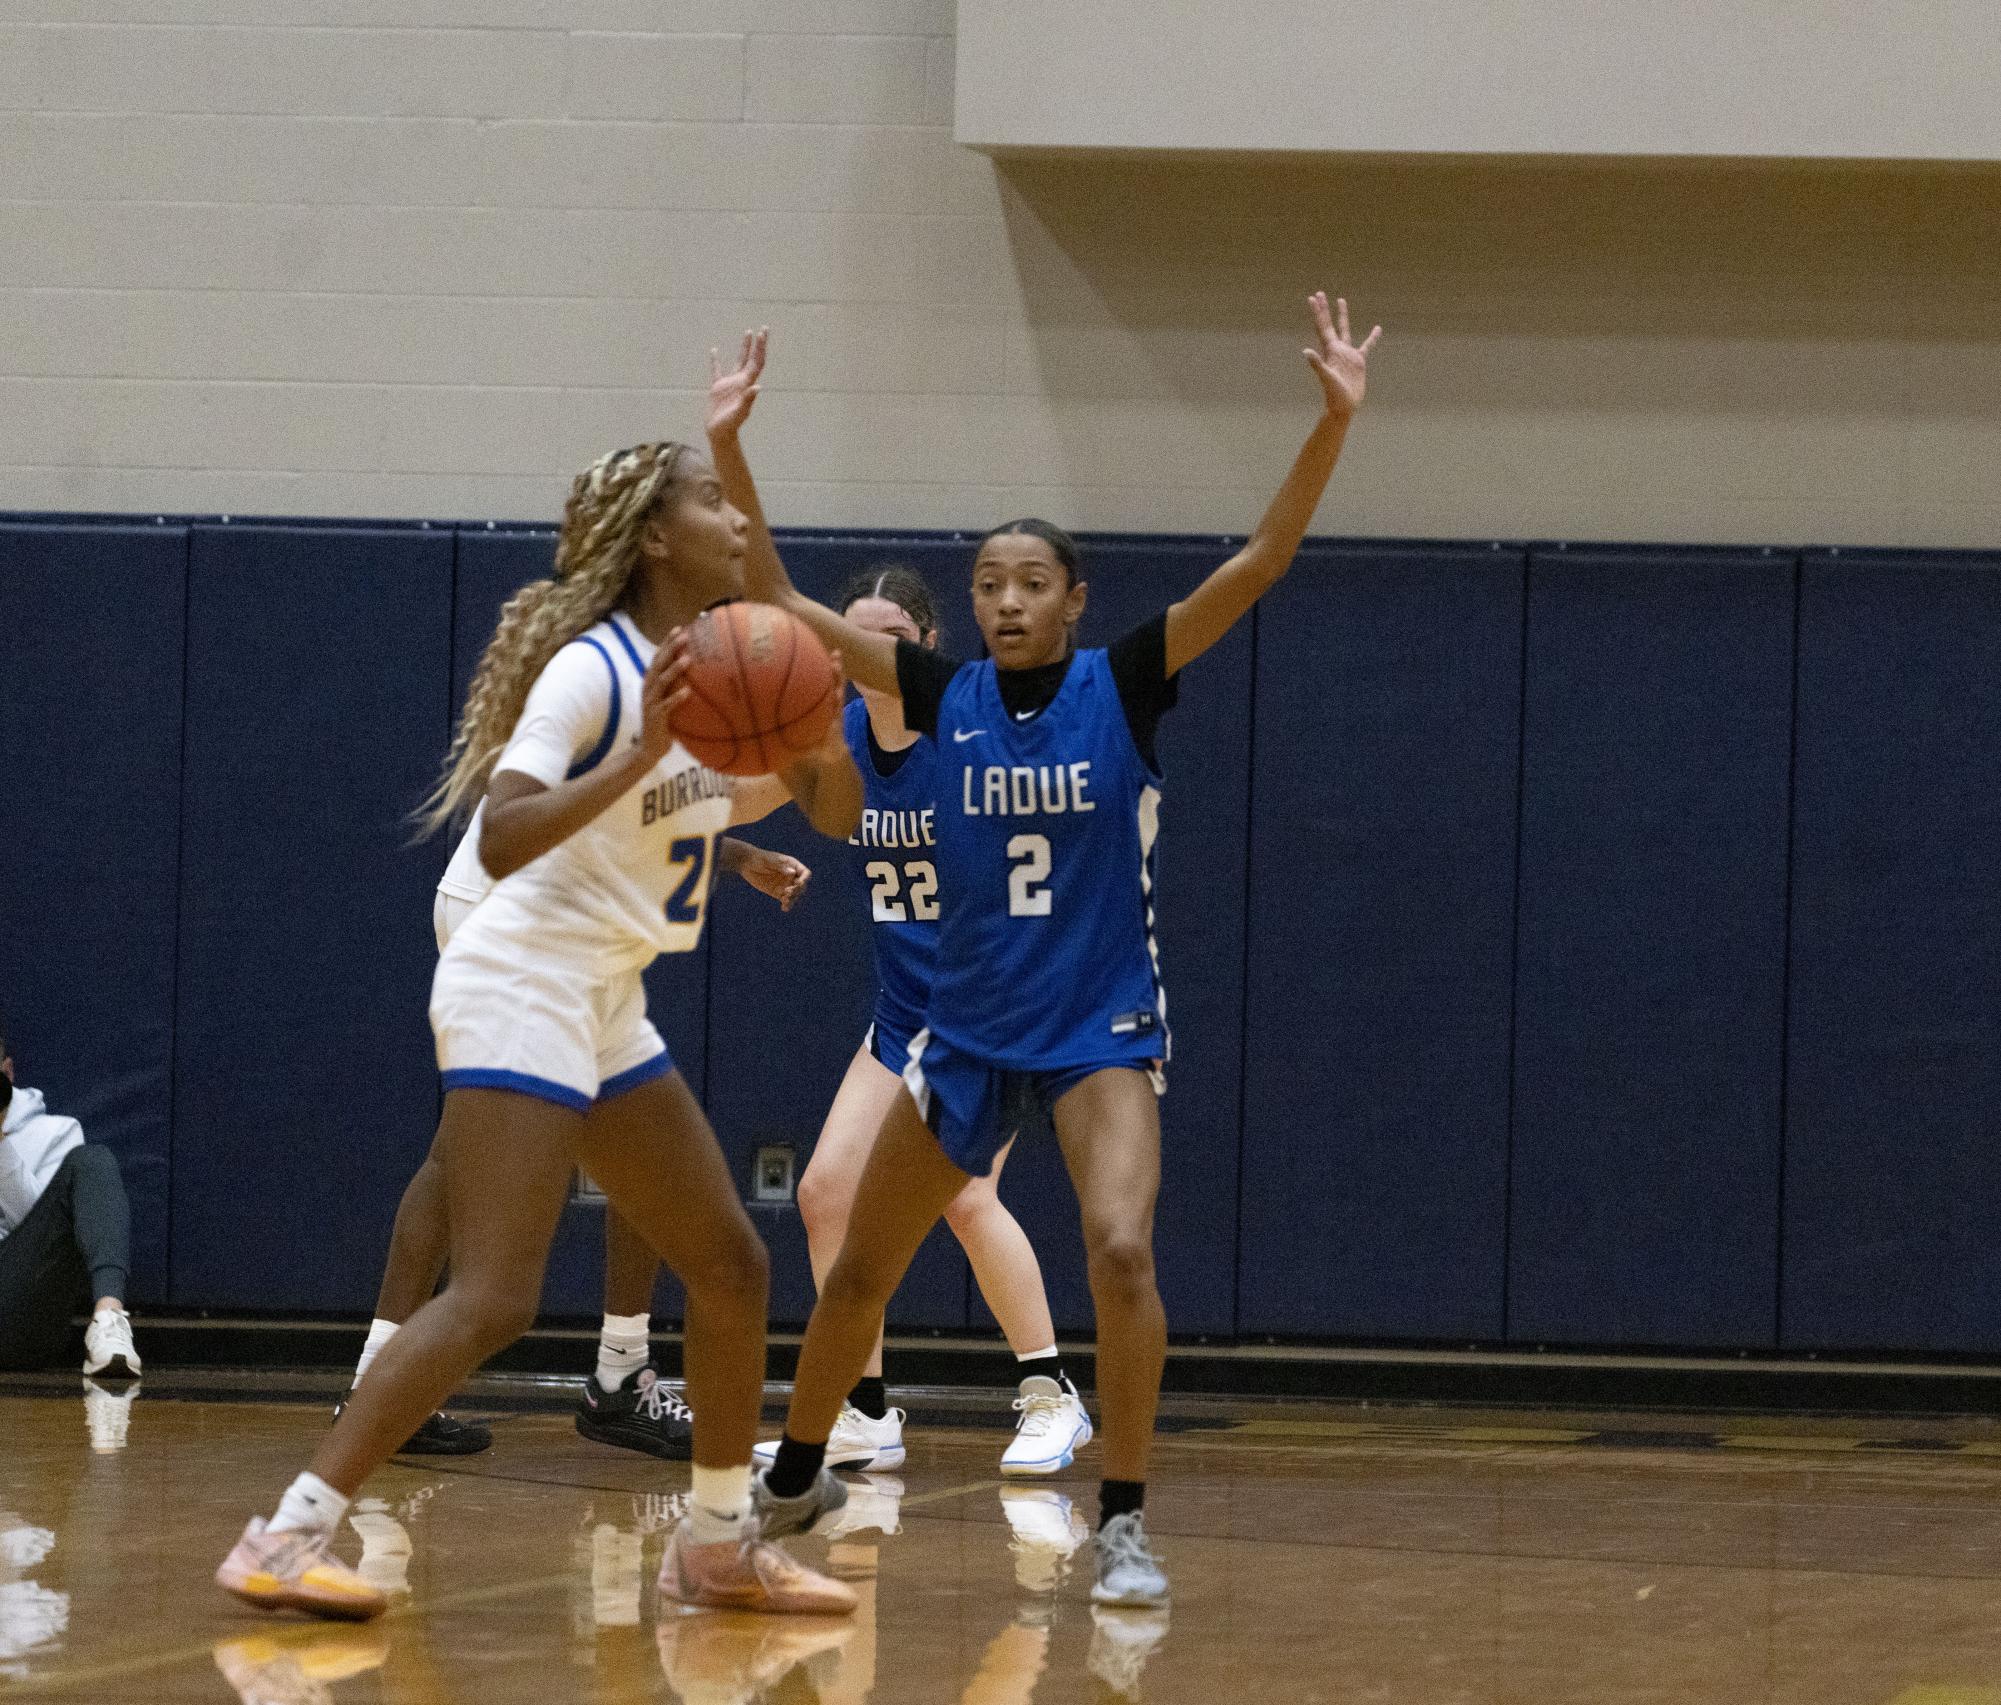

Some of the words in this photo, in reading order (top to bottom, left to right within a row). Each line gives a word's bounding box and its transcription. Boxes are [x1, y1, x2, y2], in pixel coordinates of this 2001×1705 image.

[964, 761, 1096, 816] LADUE
[664, 834, 721, 923] 2
[865, 860, 940, 922] 22
[1007, 833, 1052, 917] 2
